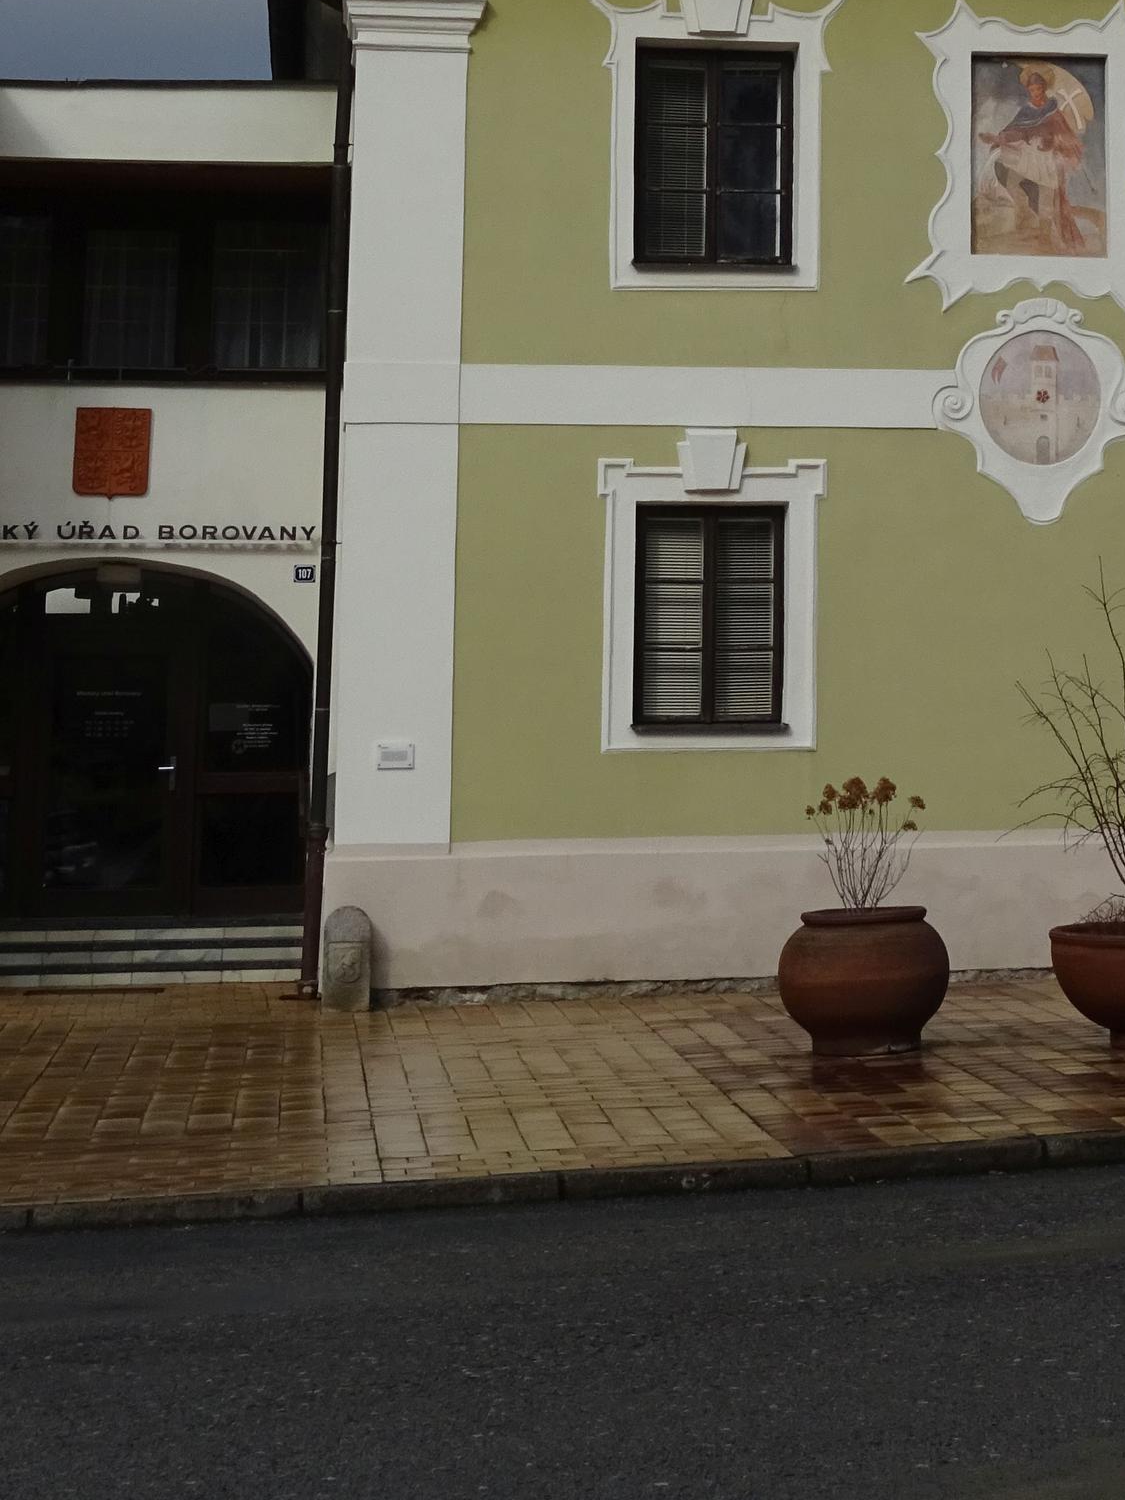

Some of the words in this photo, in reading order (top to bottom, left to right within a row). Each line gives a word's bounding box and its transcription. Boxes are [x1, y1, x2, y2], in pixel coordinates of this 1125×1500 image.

[2, 521, 39, 540] KÝ
[57, 520, 140, 540] ÚŘAD
[158, 523, 316, 540] BOROVANY
[298, 568, 312, 579] 107
